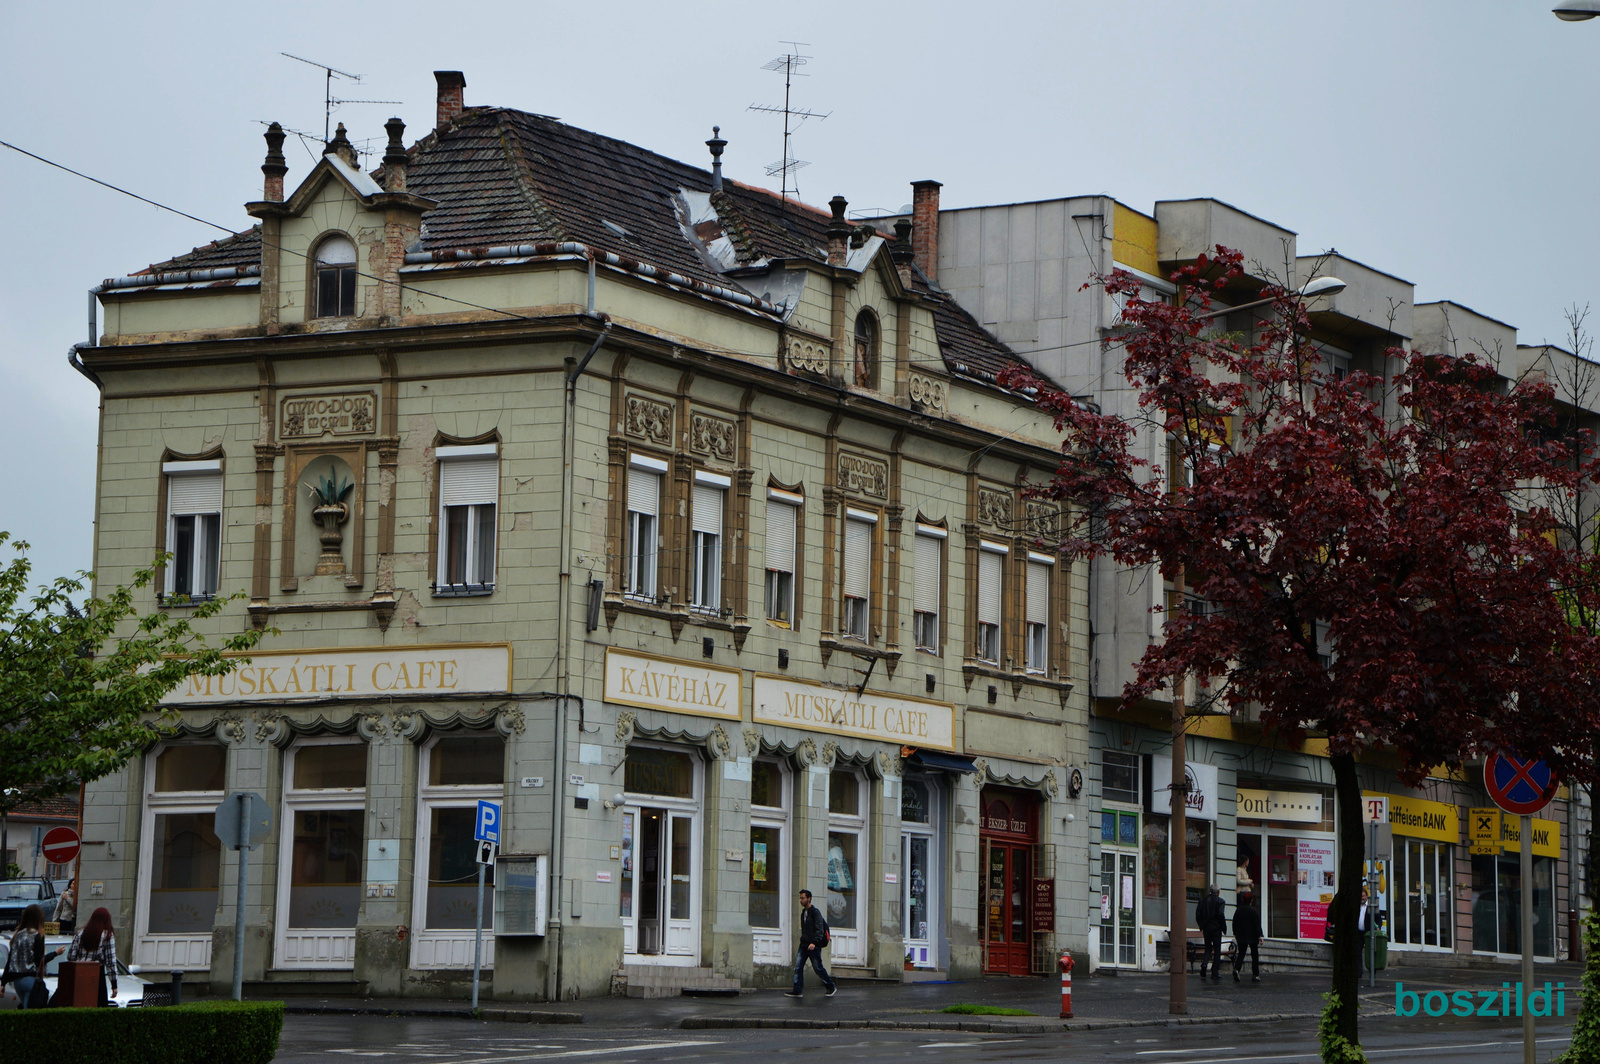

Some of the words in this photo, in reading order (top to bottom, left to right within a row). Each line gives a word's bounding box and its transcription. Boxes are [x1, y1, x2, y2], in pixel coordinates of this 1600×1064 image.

[185, 658, 357, 697] MUSKÁTLI
[371, 659, 459, 691] CAFE
[619, 661, 728, 710] KÁVÉHÁZ
[783, 692, 877, 731] MUSKÁTLI
[883, 706, 929, 738] CAFE
[480, 805, 496, 837] P
[1010, 818, 1027, 832] ÜZLET
[1389, 806, 1422, 828] aiffeisen
[1423, 812, 1446, 831] BANK
[1532, 829, 1549, 846] ANK
